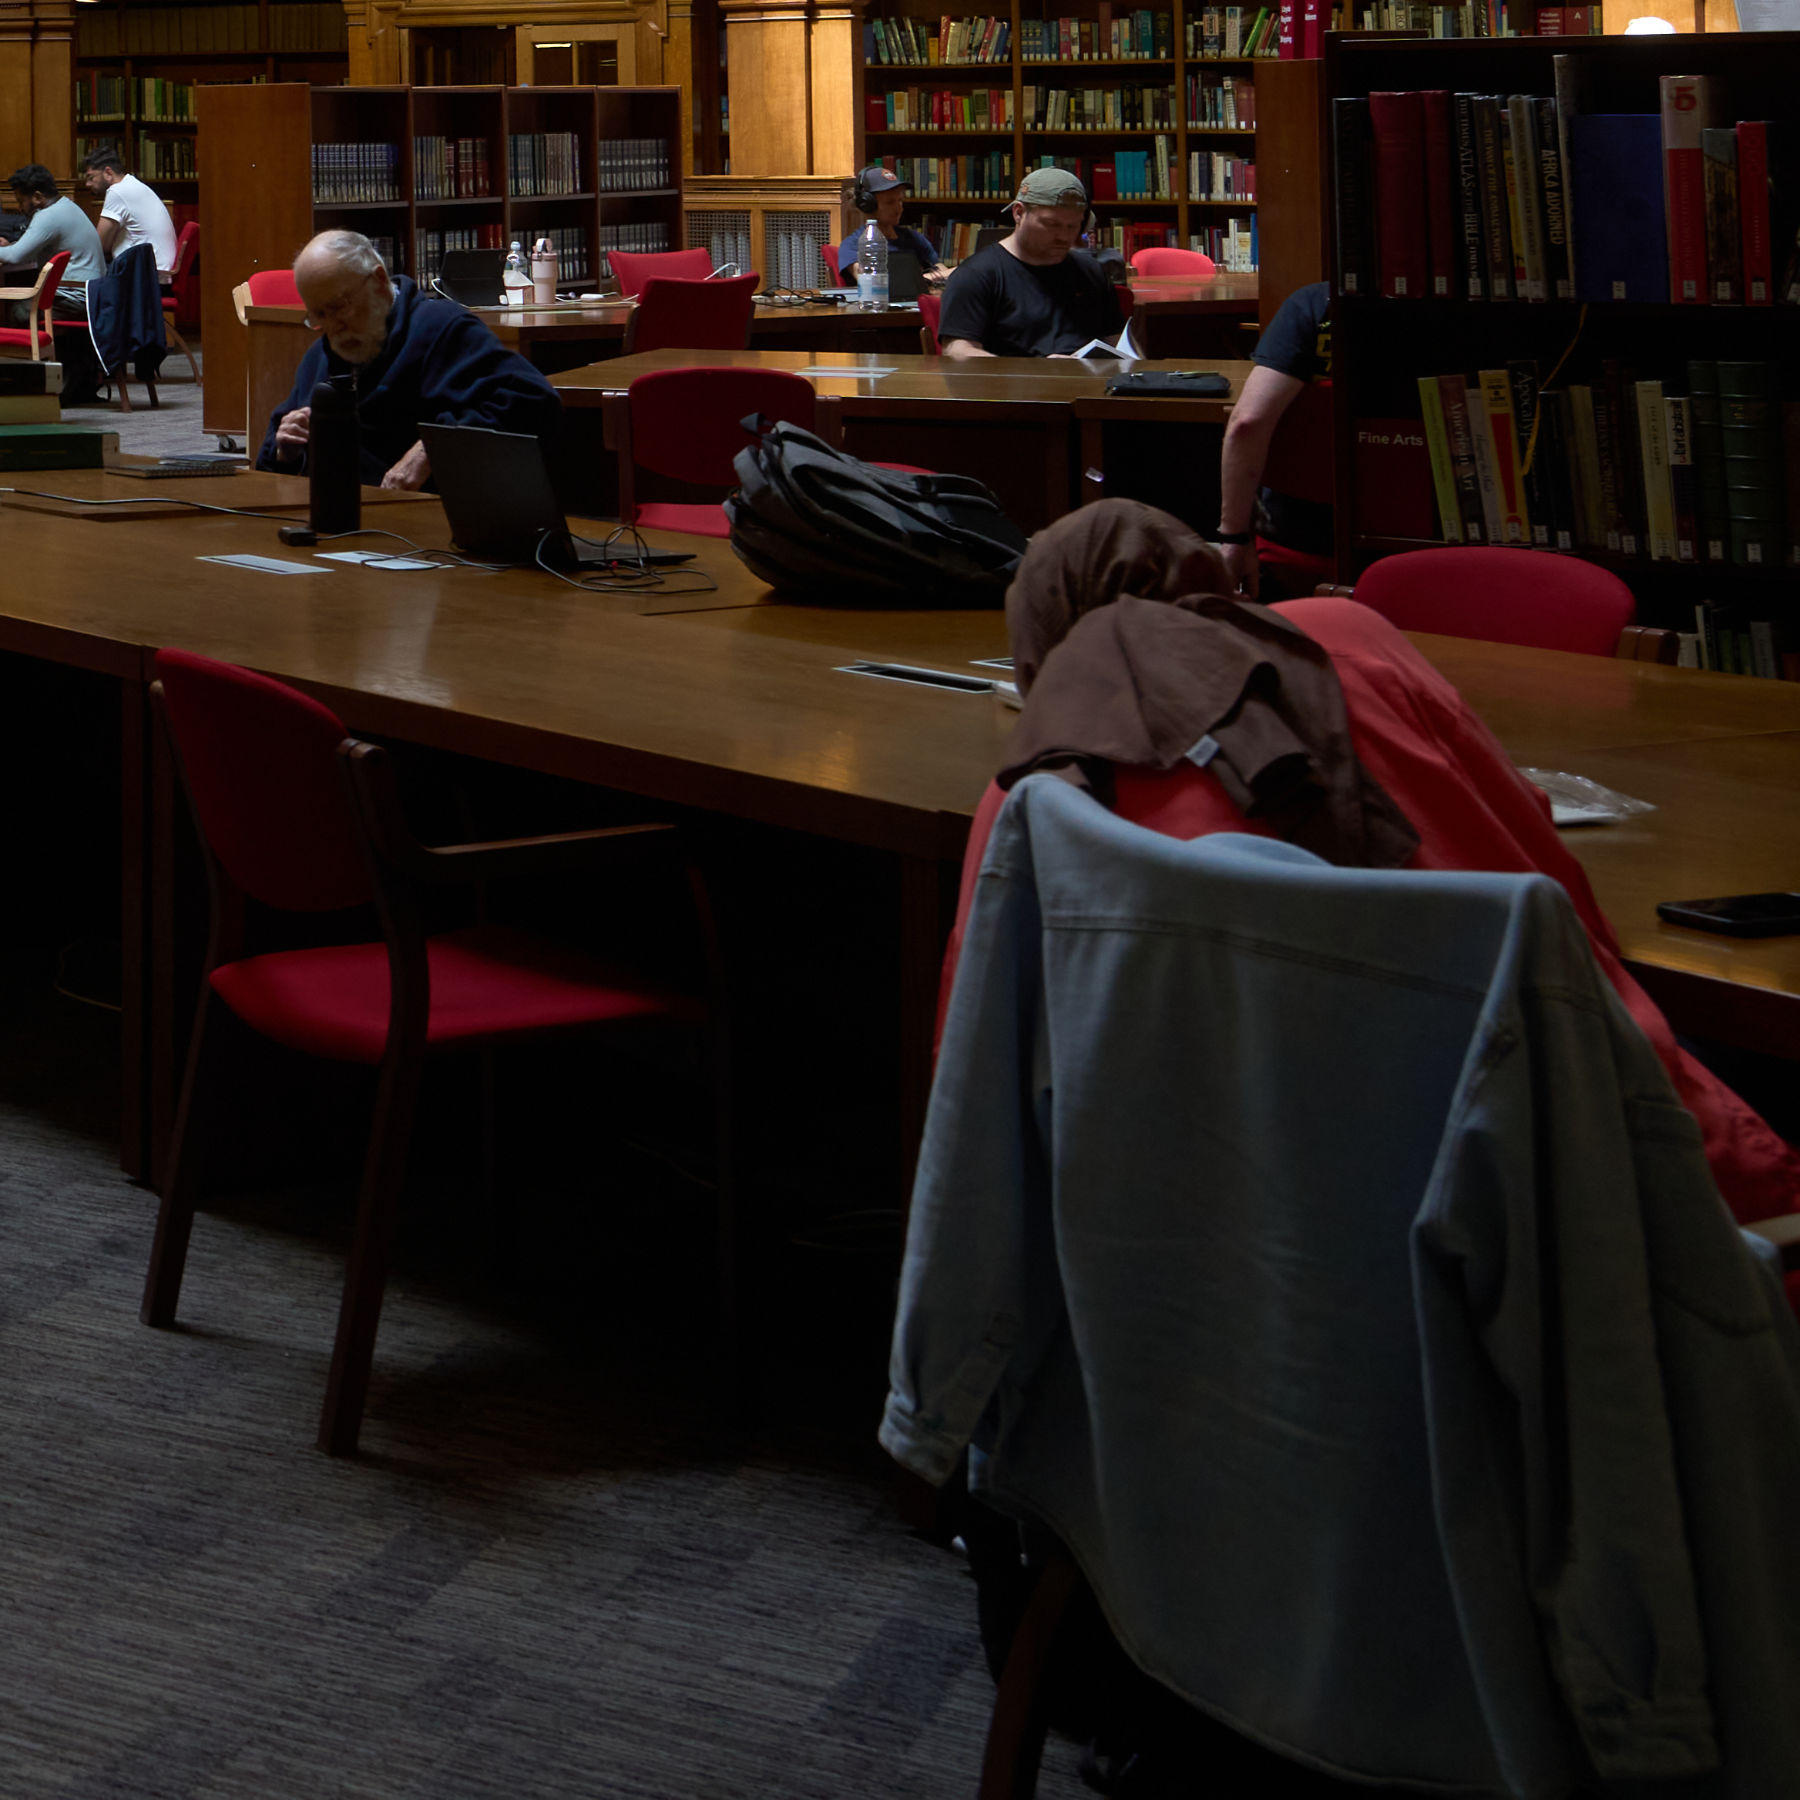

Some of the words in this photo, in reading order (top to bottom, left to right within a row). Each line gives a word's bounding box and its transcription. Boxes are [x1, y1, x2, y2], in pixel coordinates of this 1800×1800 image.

[1674, 86, 1697, 111] 5
[1461, 119, 1470, 146] TIMES
[1484, 129, 1494, 143] THE
[1460, 147, 1475, 188] ATLAS
[1485, 145, 1496, 164] WAY
[1541, 149, 1557, 189] AFRICA
[1489, 193, 1500, 227] ANIMAL
[1546, 191, 1564, 245] ADORNED
[1464, 213, 1479, 245] BIBLE
[1491, 228, 1502, 263] POWERS
[1358, 431, 1390, 444] Fine
[1393, 434, 1424, 446] Arts
[1449, 402, 1469, 465] American
[1462, 471, 1476, 491] Art
